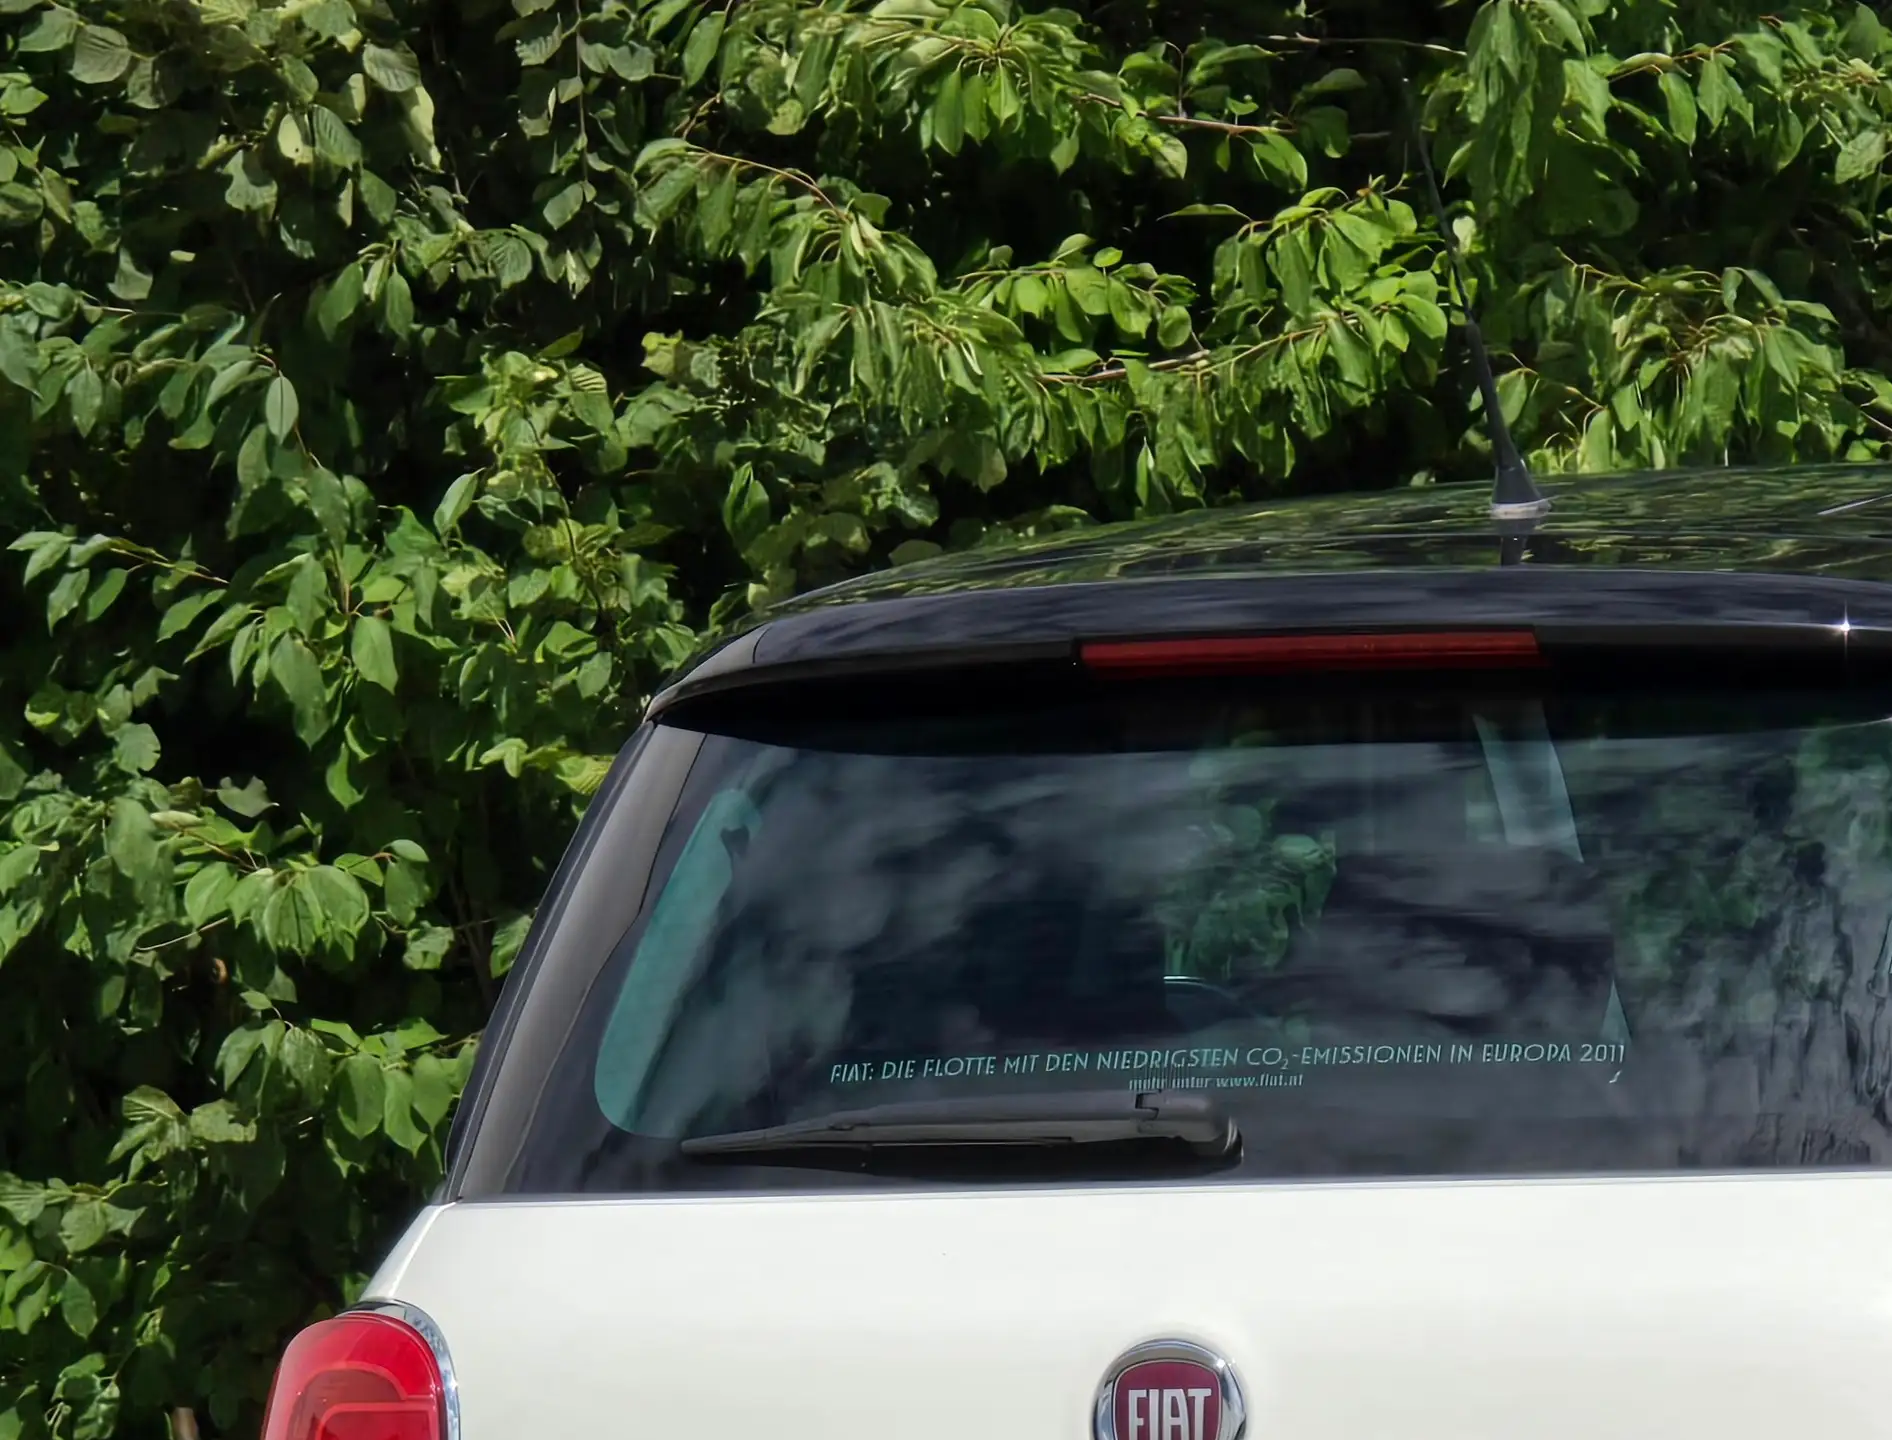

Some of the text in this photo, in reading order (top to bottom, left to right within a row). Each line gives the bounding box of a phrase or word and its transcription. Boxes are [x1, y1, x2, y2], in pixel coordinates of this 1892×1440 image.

[830, 1061, 874, 1083] FIAT:
[881, 1060, 916, 1079] DIE
[923, 1055, 997, 1078] FLOTTE
[1003, 1053, 1040, 1074] MIT
[1045, 1052, 1089, 1072] DEN
[1096, 1047, 1238, 1070] NIEDRIGSTEN
[1449, 1043, 1473, 1063] IN
[1482, 1043, 1571, 1063] EUROPA
[1580, 1043, 1625, 1063] 2011
